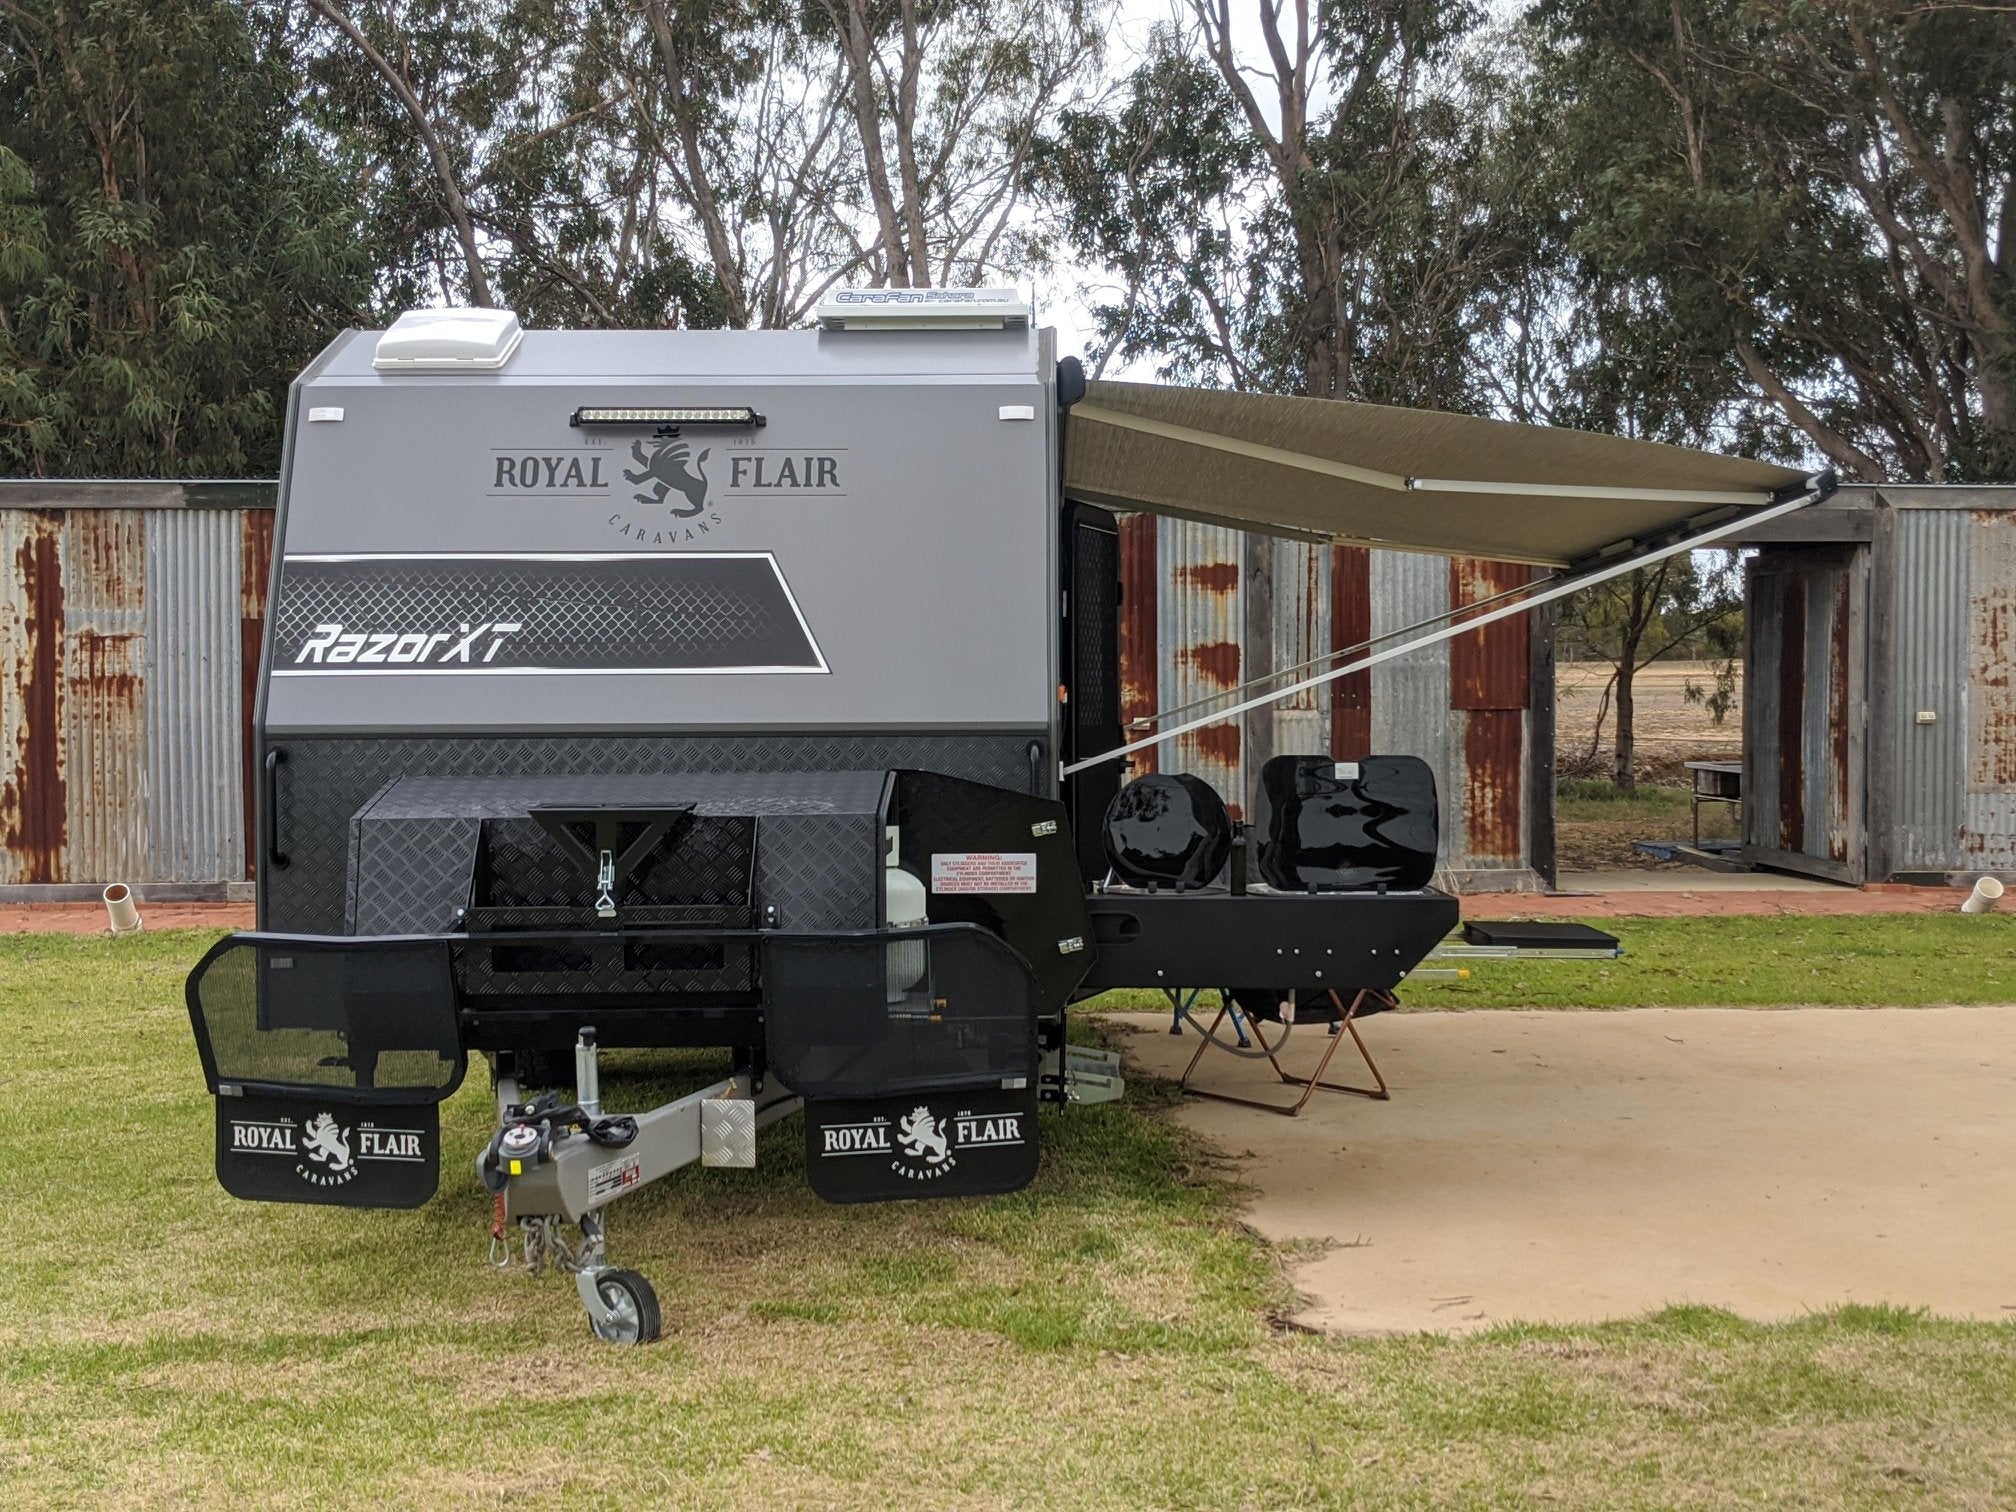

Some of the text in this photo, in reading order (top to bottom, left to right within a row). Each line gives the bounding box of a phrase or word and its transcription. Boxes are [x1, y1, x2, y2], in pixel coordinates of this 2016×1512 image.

[836, 291, 974, 303] CaraFan Sahara
[494, 456, 841, 488] ROYAL FLAIR
[608, 513, 723, 545] CARAVANS
[233, 1126, 422, 1156] ROYAL FLAIR
[824, 1118, 1021, 1151] ROYAL FLAIR
[295, 1164, 359, 1186] CARAVANS
[891, 1160, 957, 1181] CARAVANS
